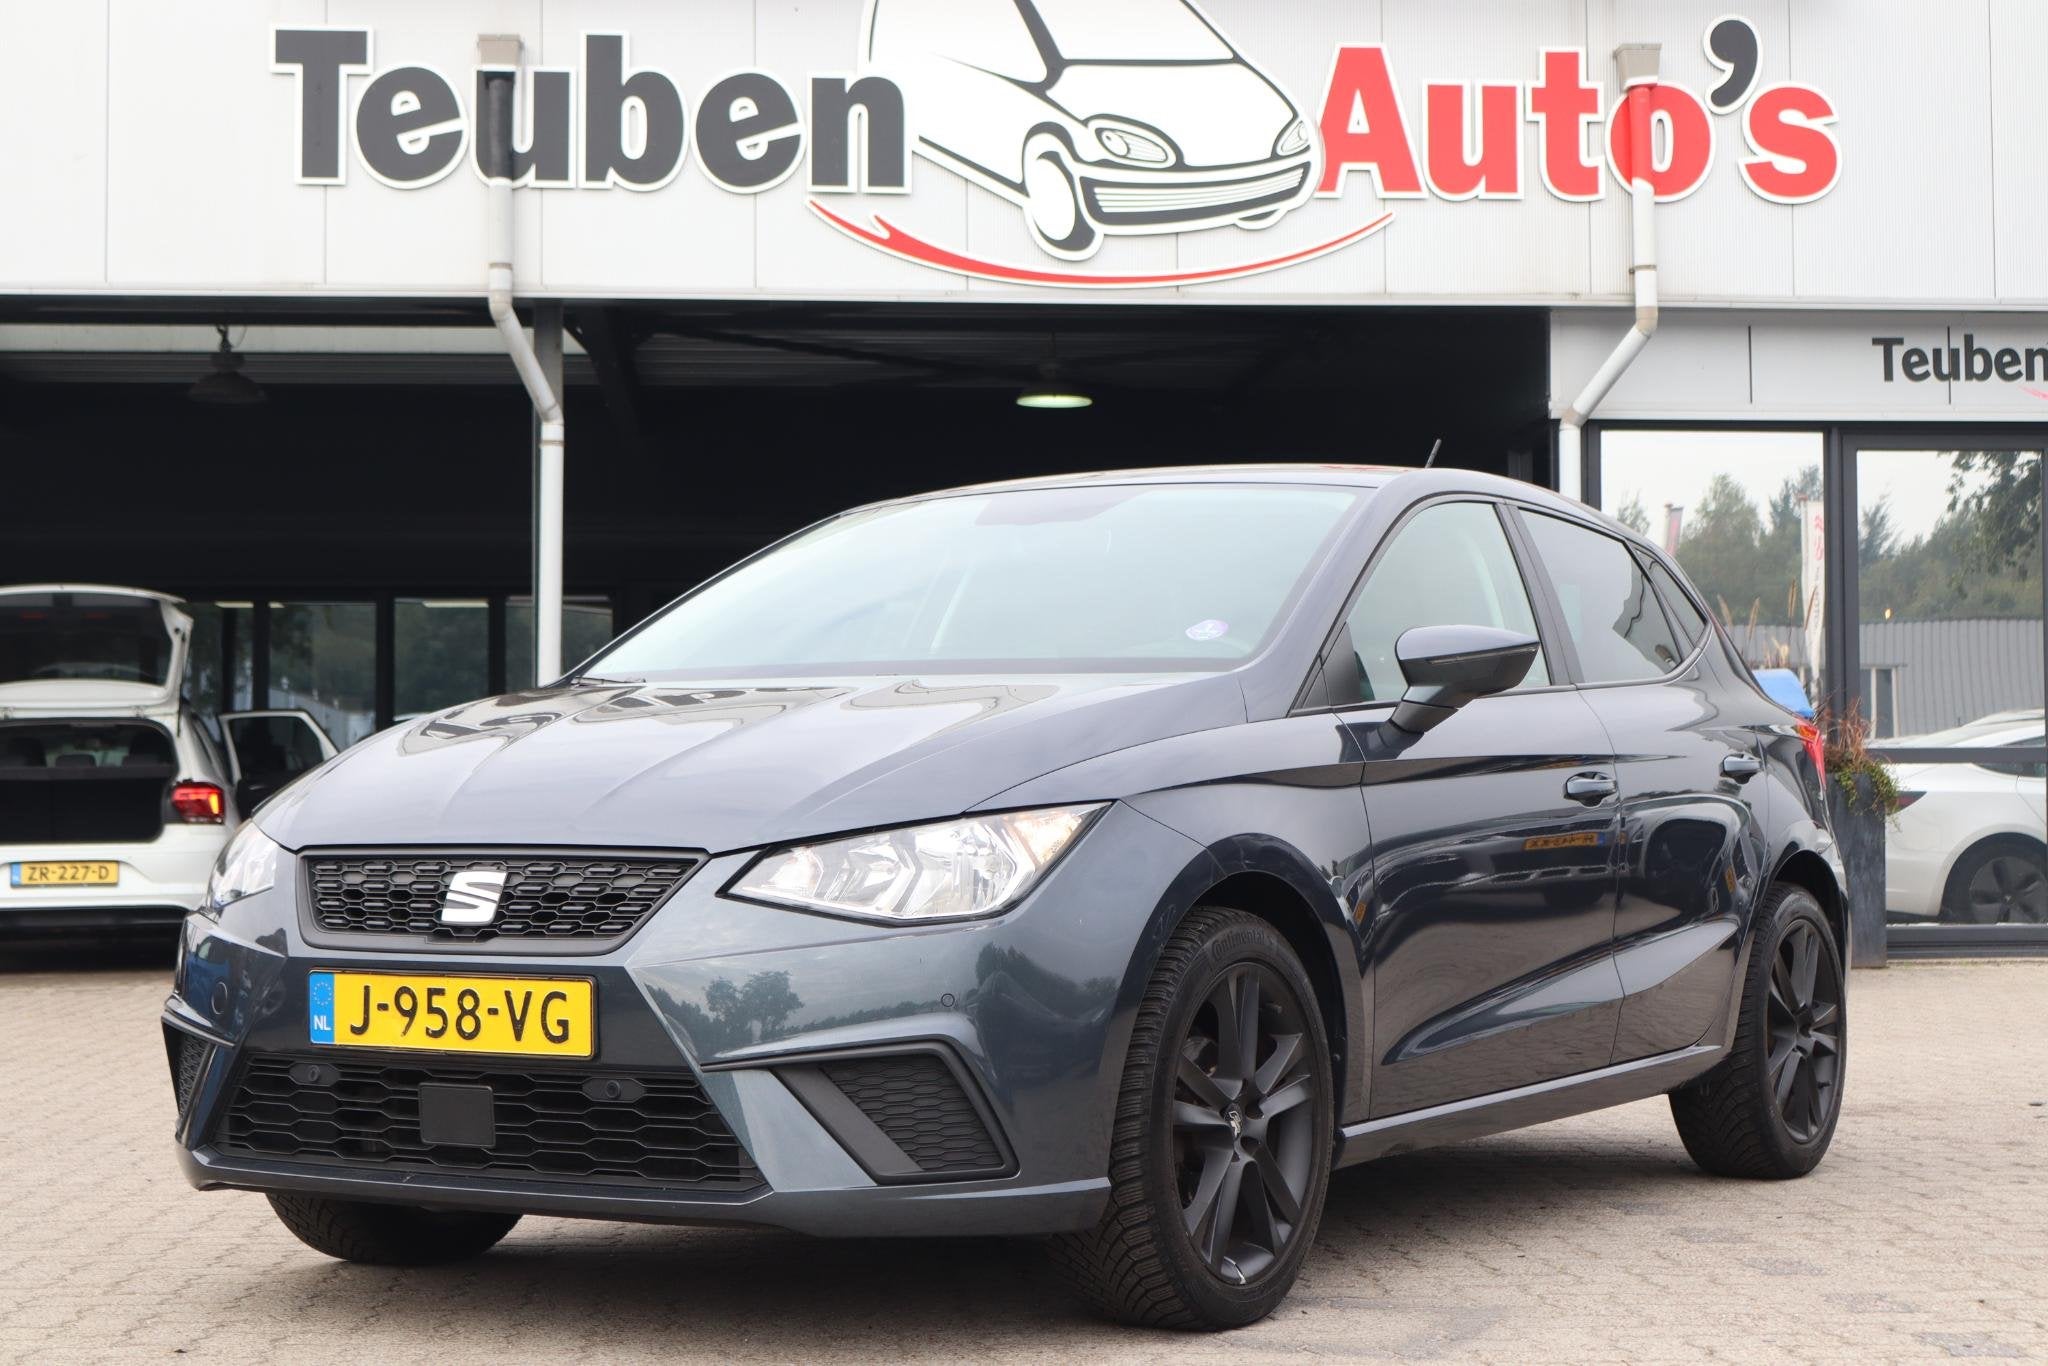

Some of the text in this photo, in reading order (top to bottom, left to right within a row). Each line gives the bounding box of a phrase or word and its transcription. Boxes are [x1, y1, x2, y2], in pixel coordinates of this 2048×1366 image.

[272, 17, 1842, 198] Teuben Auto's
[1871, 333, 2048, 382] Teuben
[27, 865, 110, 881] ZR-227-D
[313, 984, 570, 1044] NL J-958-VG
